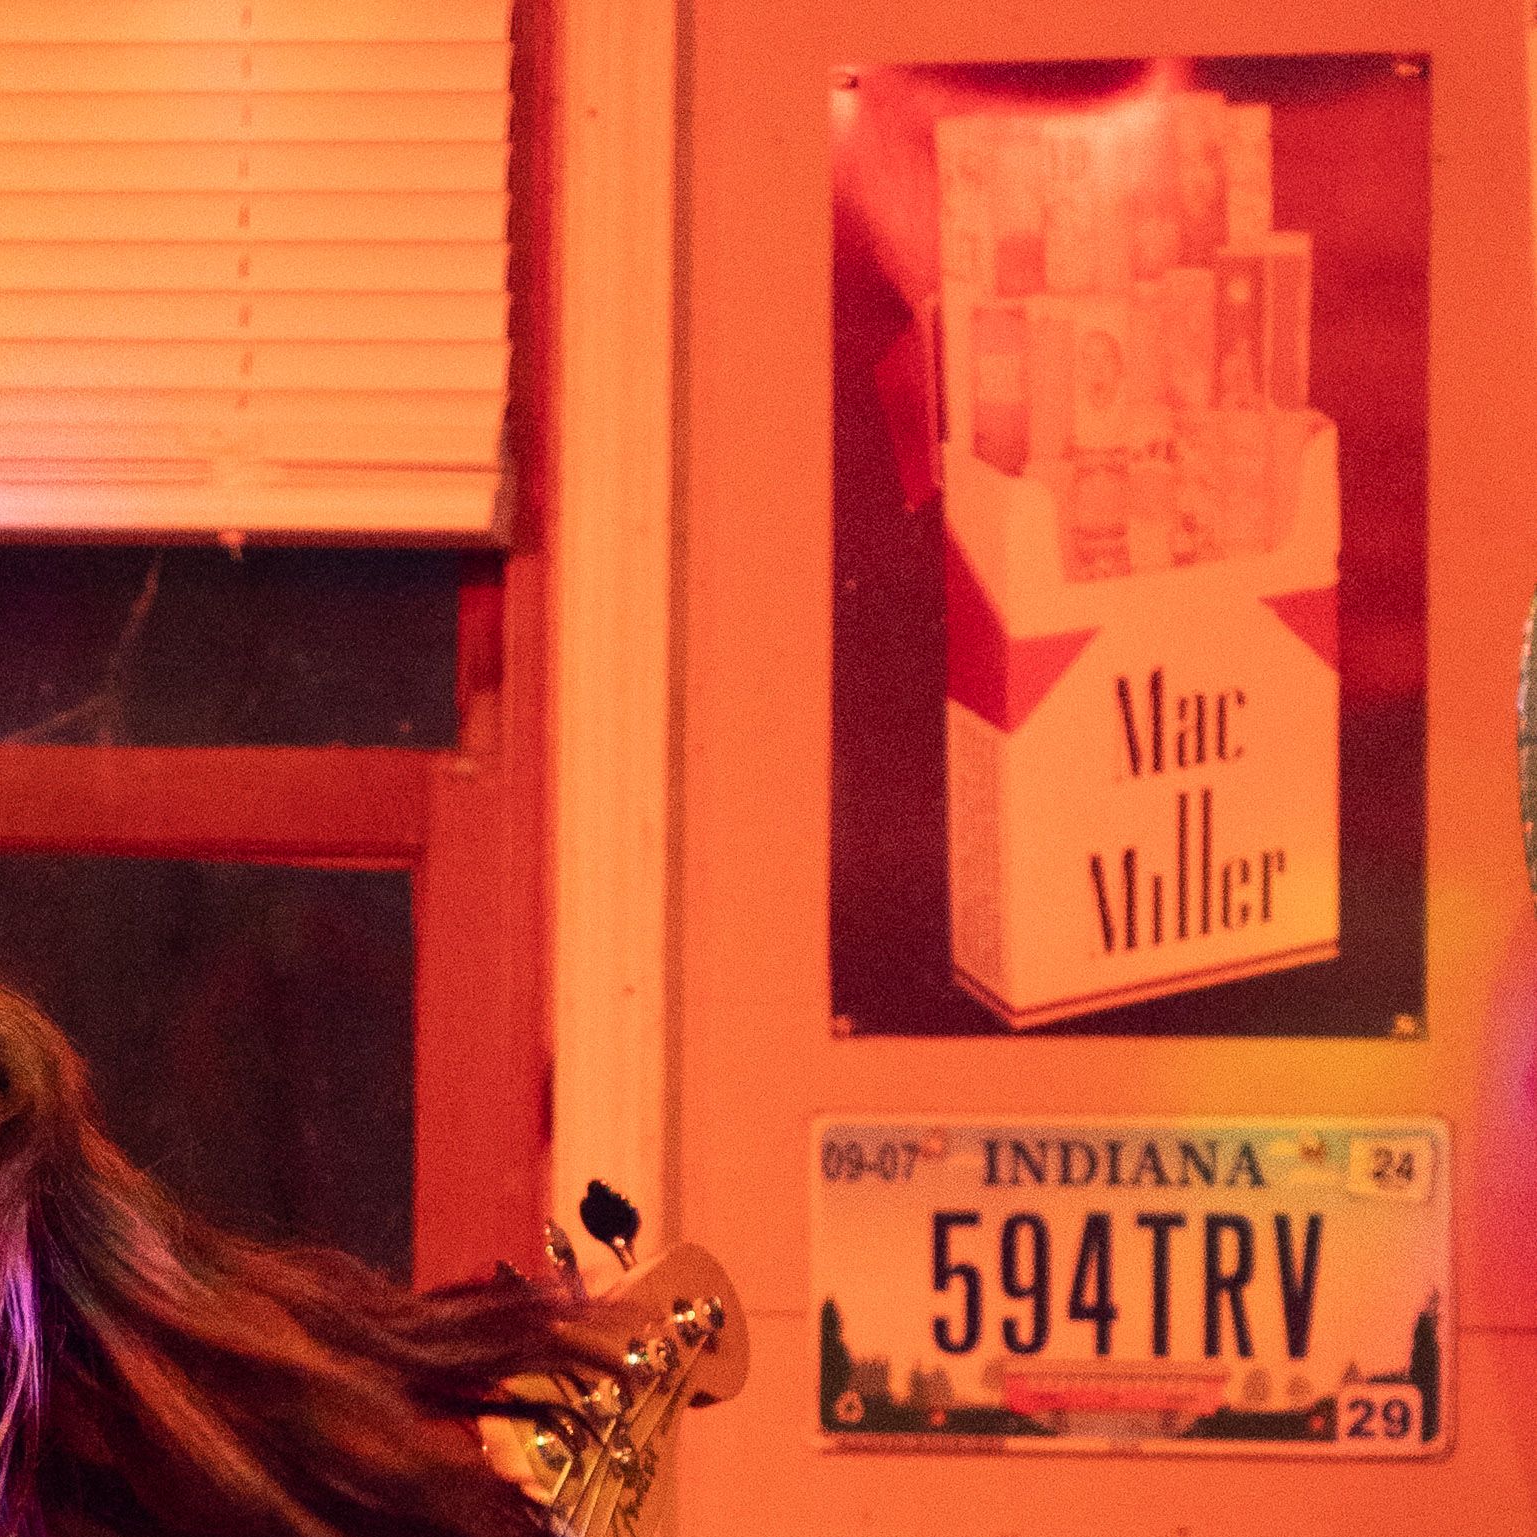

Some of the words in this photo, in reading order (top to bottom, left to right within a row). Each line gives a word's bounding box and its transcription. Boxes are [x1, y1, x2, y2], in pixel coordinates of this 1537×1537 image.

[1115, 667, 1245, 777] Mac
[1089, 787, 1286, 954] Miller
[982, 1134, 1266, 1188] INDIANA
[1372, 1147, 1415, 1183] 24
[932, 1212, 1322, 1358] 594TRV
[1346, 1397, 1411, 1438] 29
